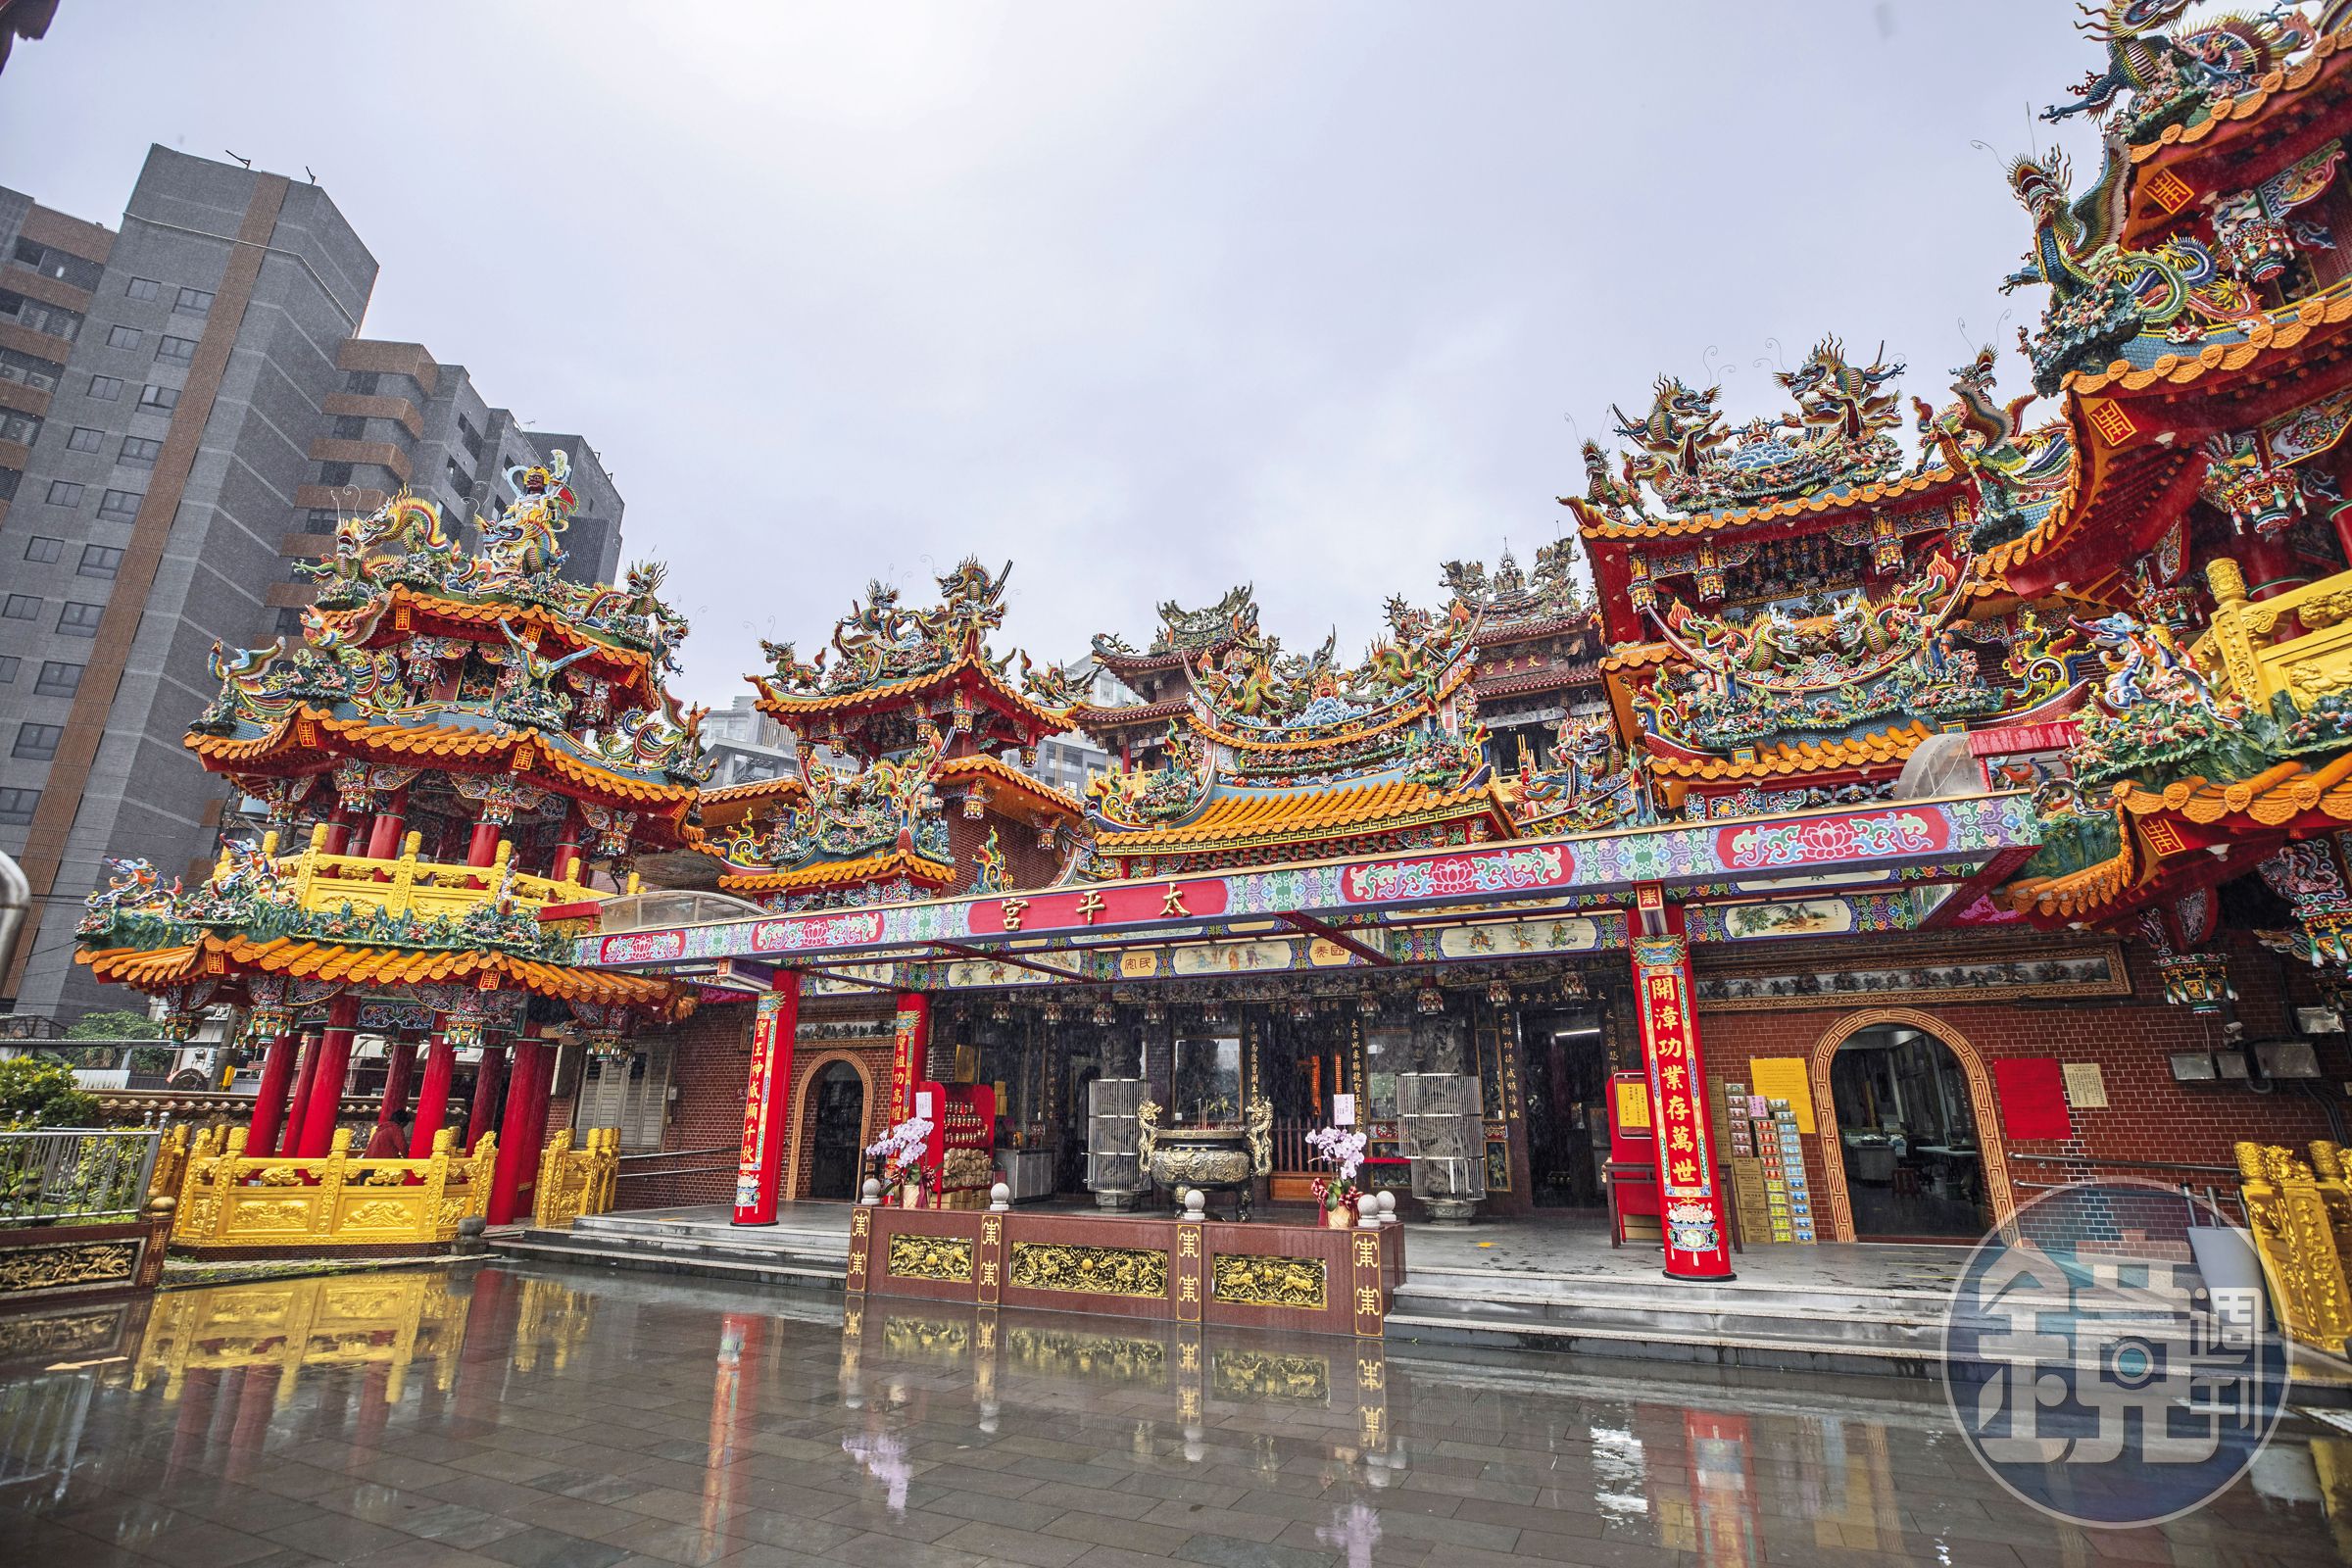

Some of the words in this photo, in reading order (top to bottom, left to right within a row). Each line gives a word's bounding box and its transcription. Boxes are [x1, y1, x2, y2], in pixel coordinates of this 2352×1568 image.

[1483, 655, 1542, 675] 太平宮
[1001, 881, 1193, 932] 太平宮
[1650, 976, 1697, 1184] 開漳功業存萬世
